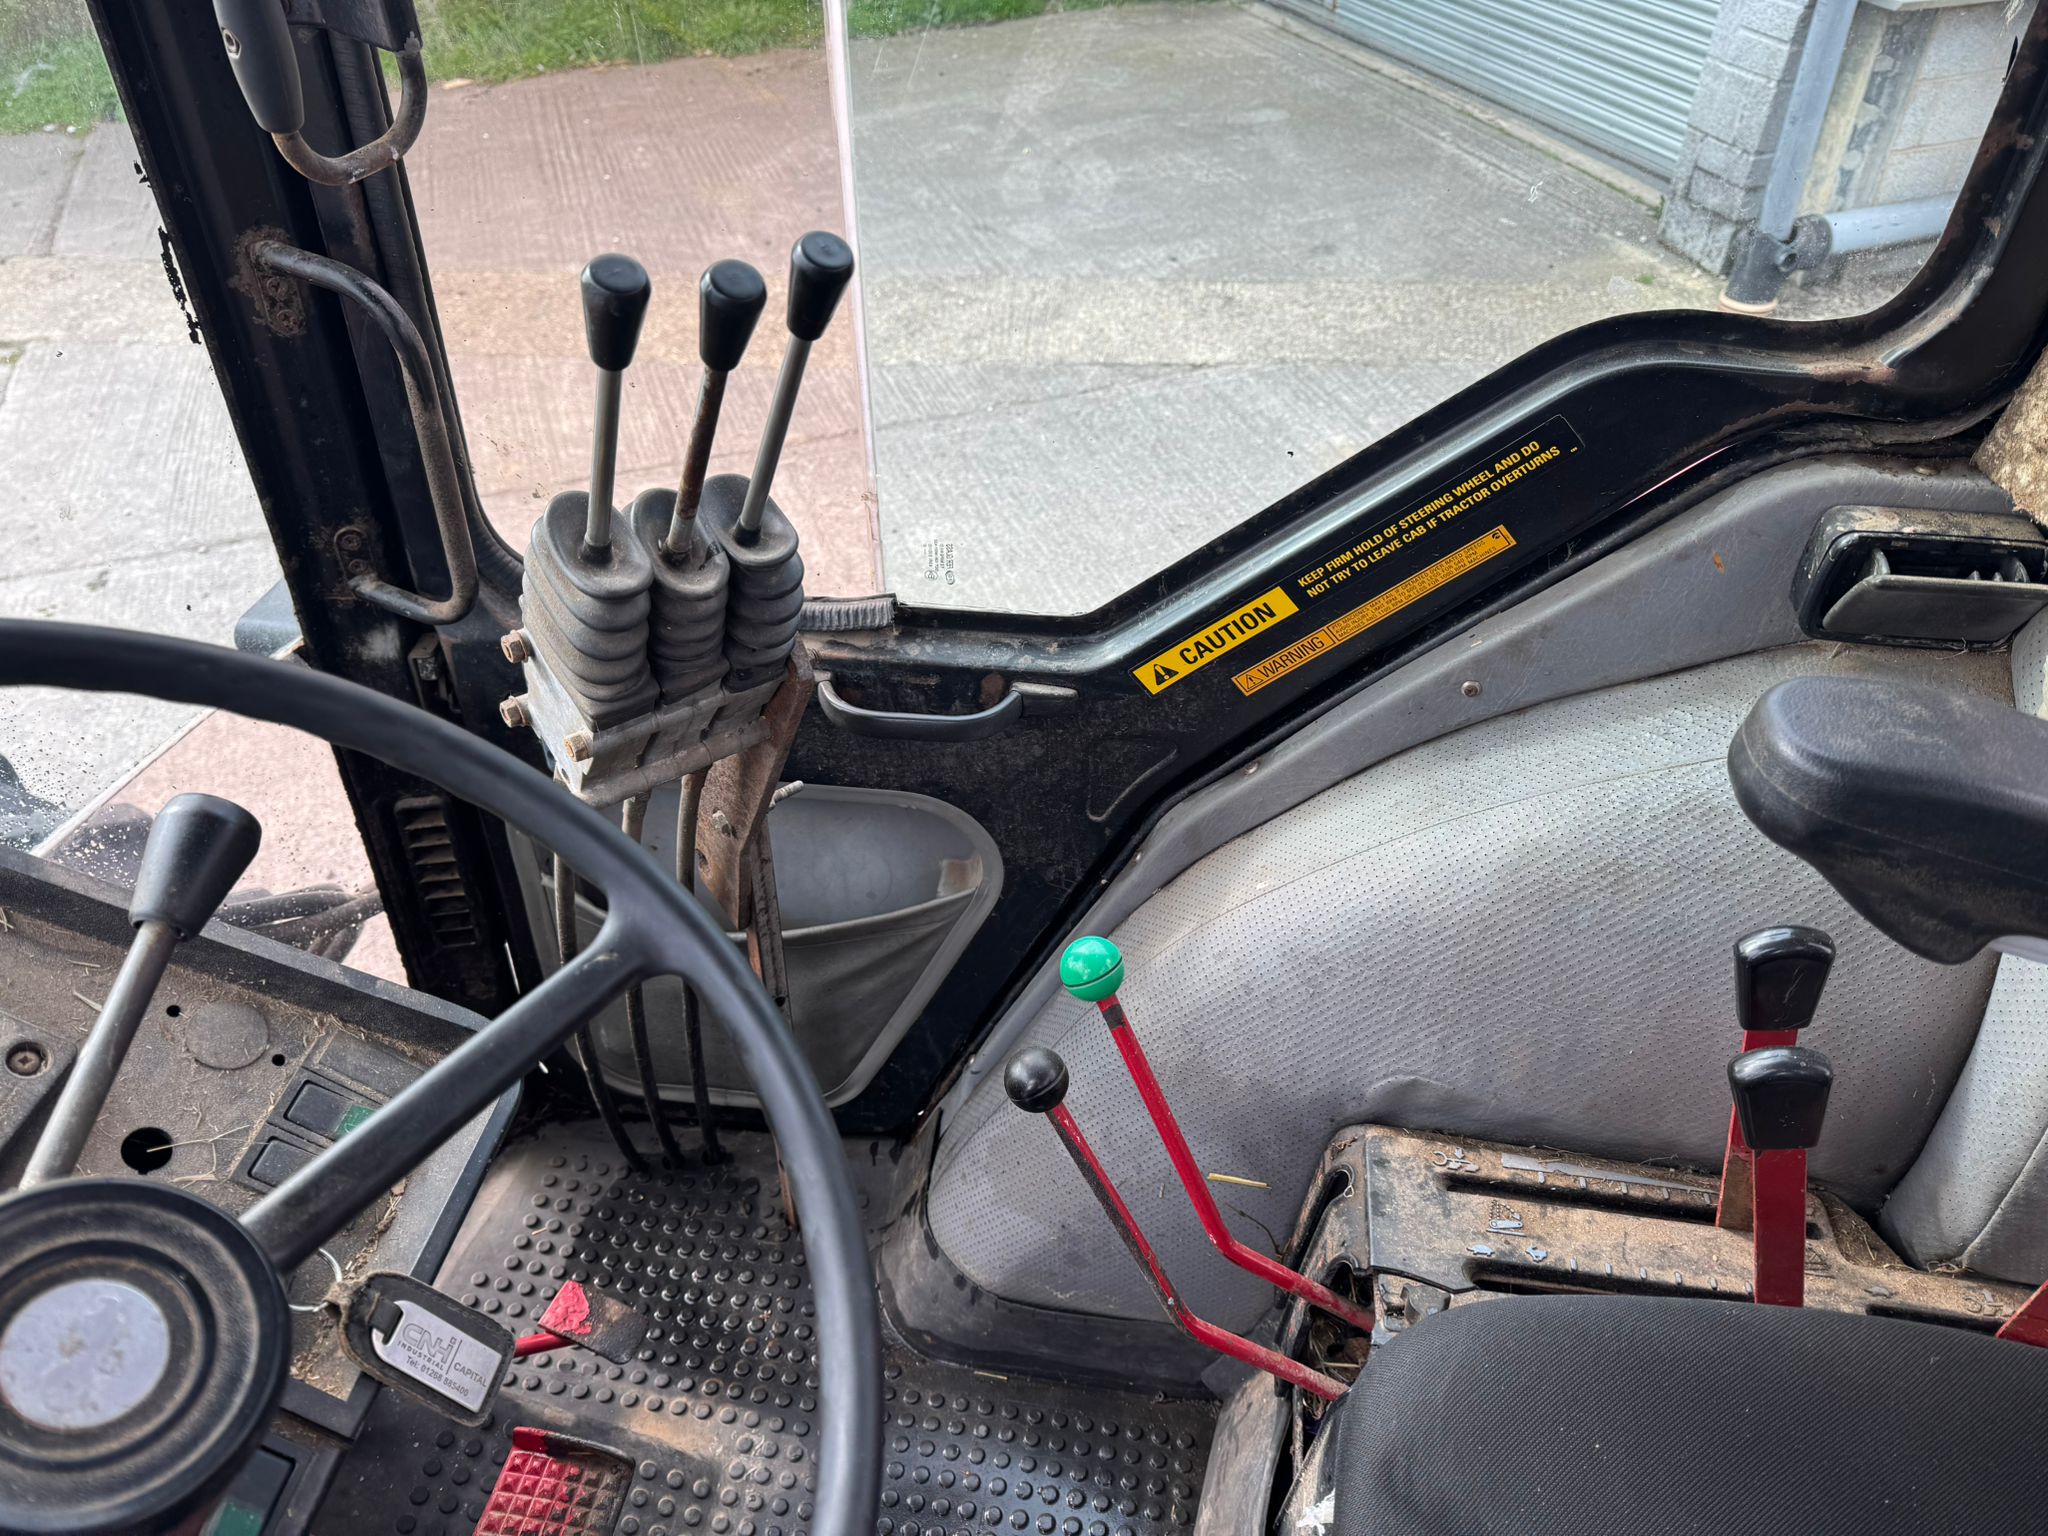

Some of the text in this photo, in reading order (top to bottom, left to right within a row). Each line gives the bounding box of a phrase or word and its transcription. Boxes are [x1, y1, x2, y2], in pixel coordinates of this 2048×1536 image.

[1297, 440, 1540, 587] KEEP FIRM HOLD OF STEERING WHEEL AND DO
[1306, 446, 1561, 598] NOT TRY TO LEAVE CAB IF TRACTOR OVERTURNS
[1401, 571, 1429, 590] OPERATED
[1444, 552, 1463, 565] RATED
[1463, 539, 1486, 555] SPEEDS
[1412, 584, 1428, 595] LESS
[1454, 562, 1467, 572] RPM
[1467, 545, 1496, 564] MACHINES
[1464, 550, 1478, 560] RPM
[1179, 602, 1277, 665] CAUTION
[1257, 636, 1325, 678] WARNING
[397, 1340, 445, 1371] INDUSTRIAL
[406, 1355, 419, 1370] Tel:
[453, 1361, 487, 1388] CAPITAL
